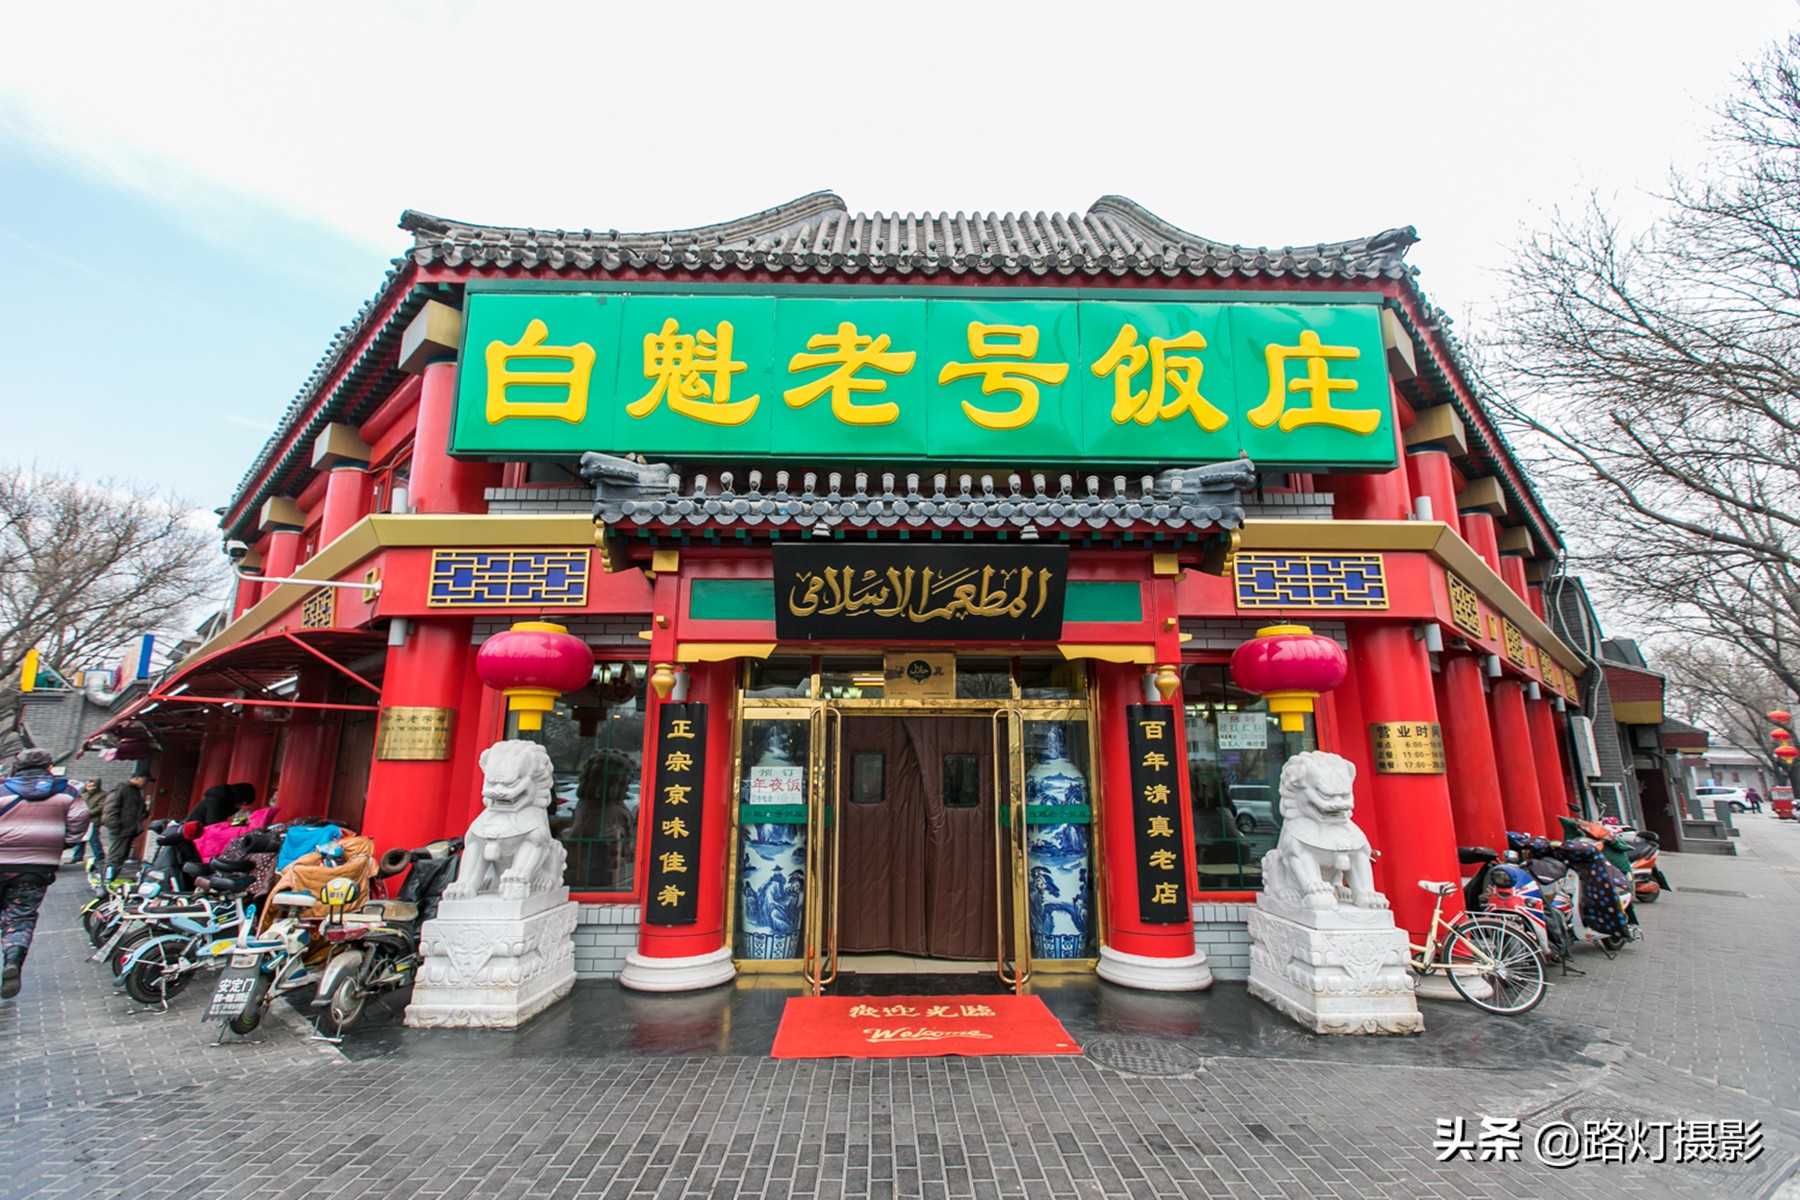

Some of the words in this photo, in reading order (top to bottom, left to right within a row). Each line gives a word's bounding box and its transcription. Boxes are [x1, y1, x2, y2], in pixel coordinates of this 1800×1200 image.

[485, 317, 1382, 435] 白魁老号饭庄
[1376, 725, 1441, 739] 营业时间
[751, 777, 801, 793] 年夜饭
[657, 719, 696, 908] 正宗京味佳肴
[1139, 720, 1180, 905] 百年清真老店
[217, 978, 256, 993] 安定门
[862, 1026, 994, 1043] Welcome
